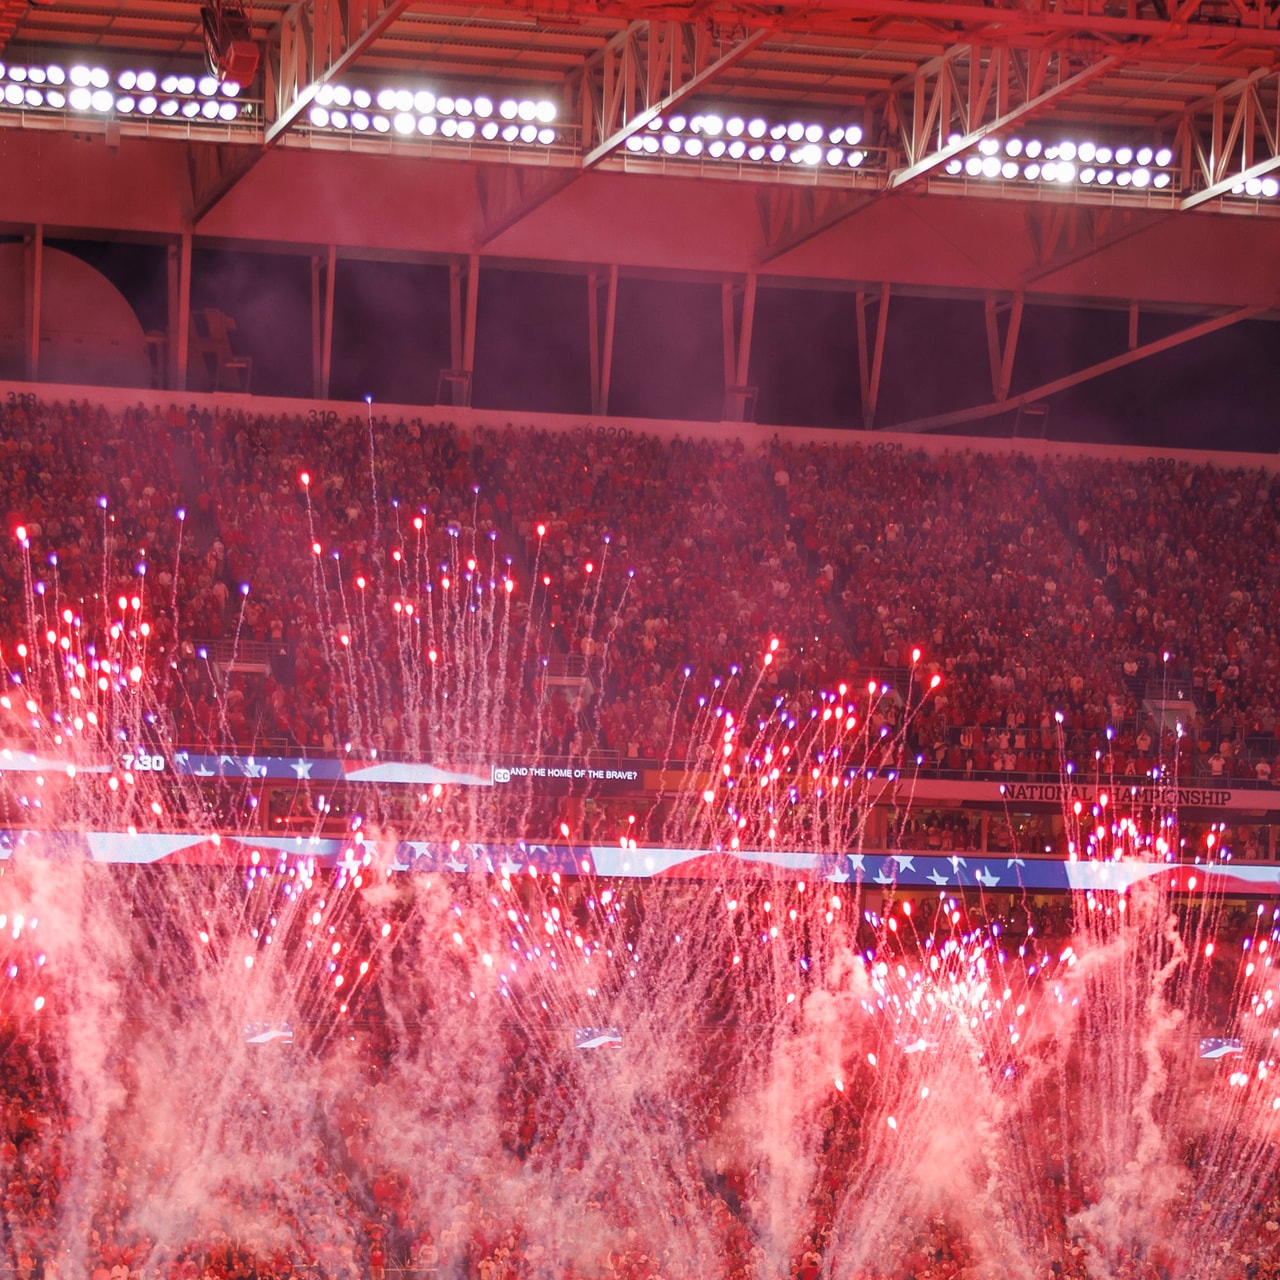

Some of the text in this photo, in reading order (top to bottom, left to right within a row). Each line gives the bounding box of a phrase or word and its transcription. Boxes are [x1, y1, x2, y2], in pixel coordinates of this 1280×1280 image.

[510, 767, 638, 780] AND THE HOME OF THE BRAVE?
[1003, 785, 1092, 801] NATIONAL
